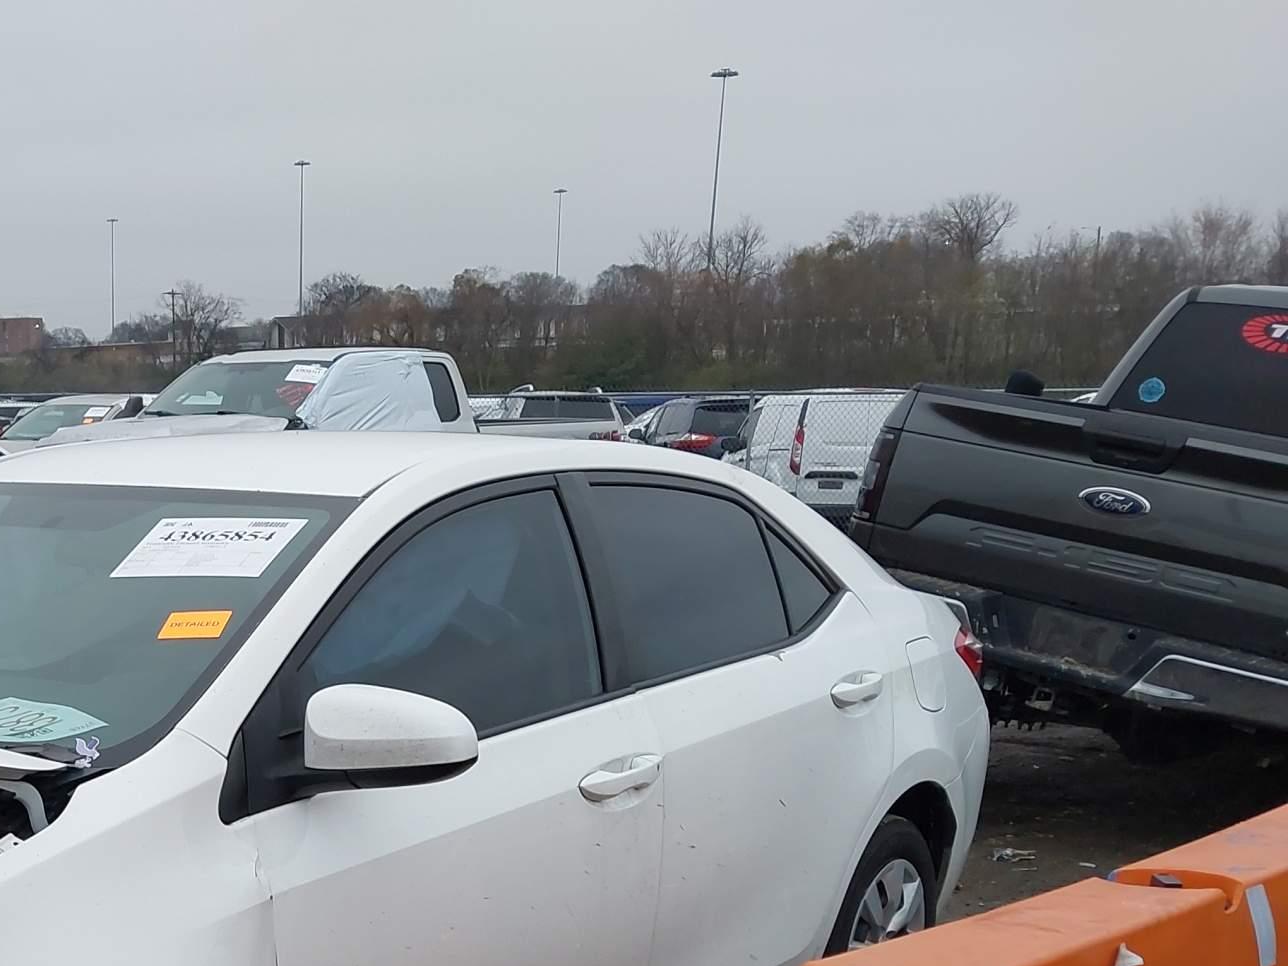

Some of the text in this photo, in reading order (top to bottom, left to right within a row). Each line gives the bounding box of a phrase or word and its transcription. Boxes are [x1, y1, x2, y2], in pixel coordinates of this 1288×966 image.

[1093, 491, 1133, 513] Ford
[159, 529, 277, 542] 43865854
[965, 525, 1239, 605] F-150
[169, 620, 220, 628] DETAILED
